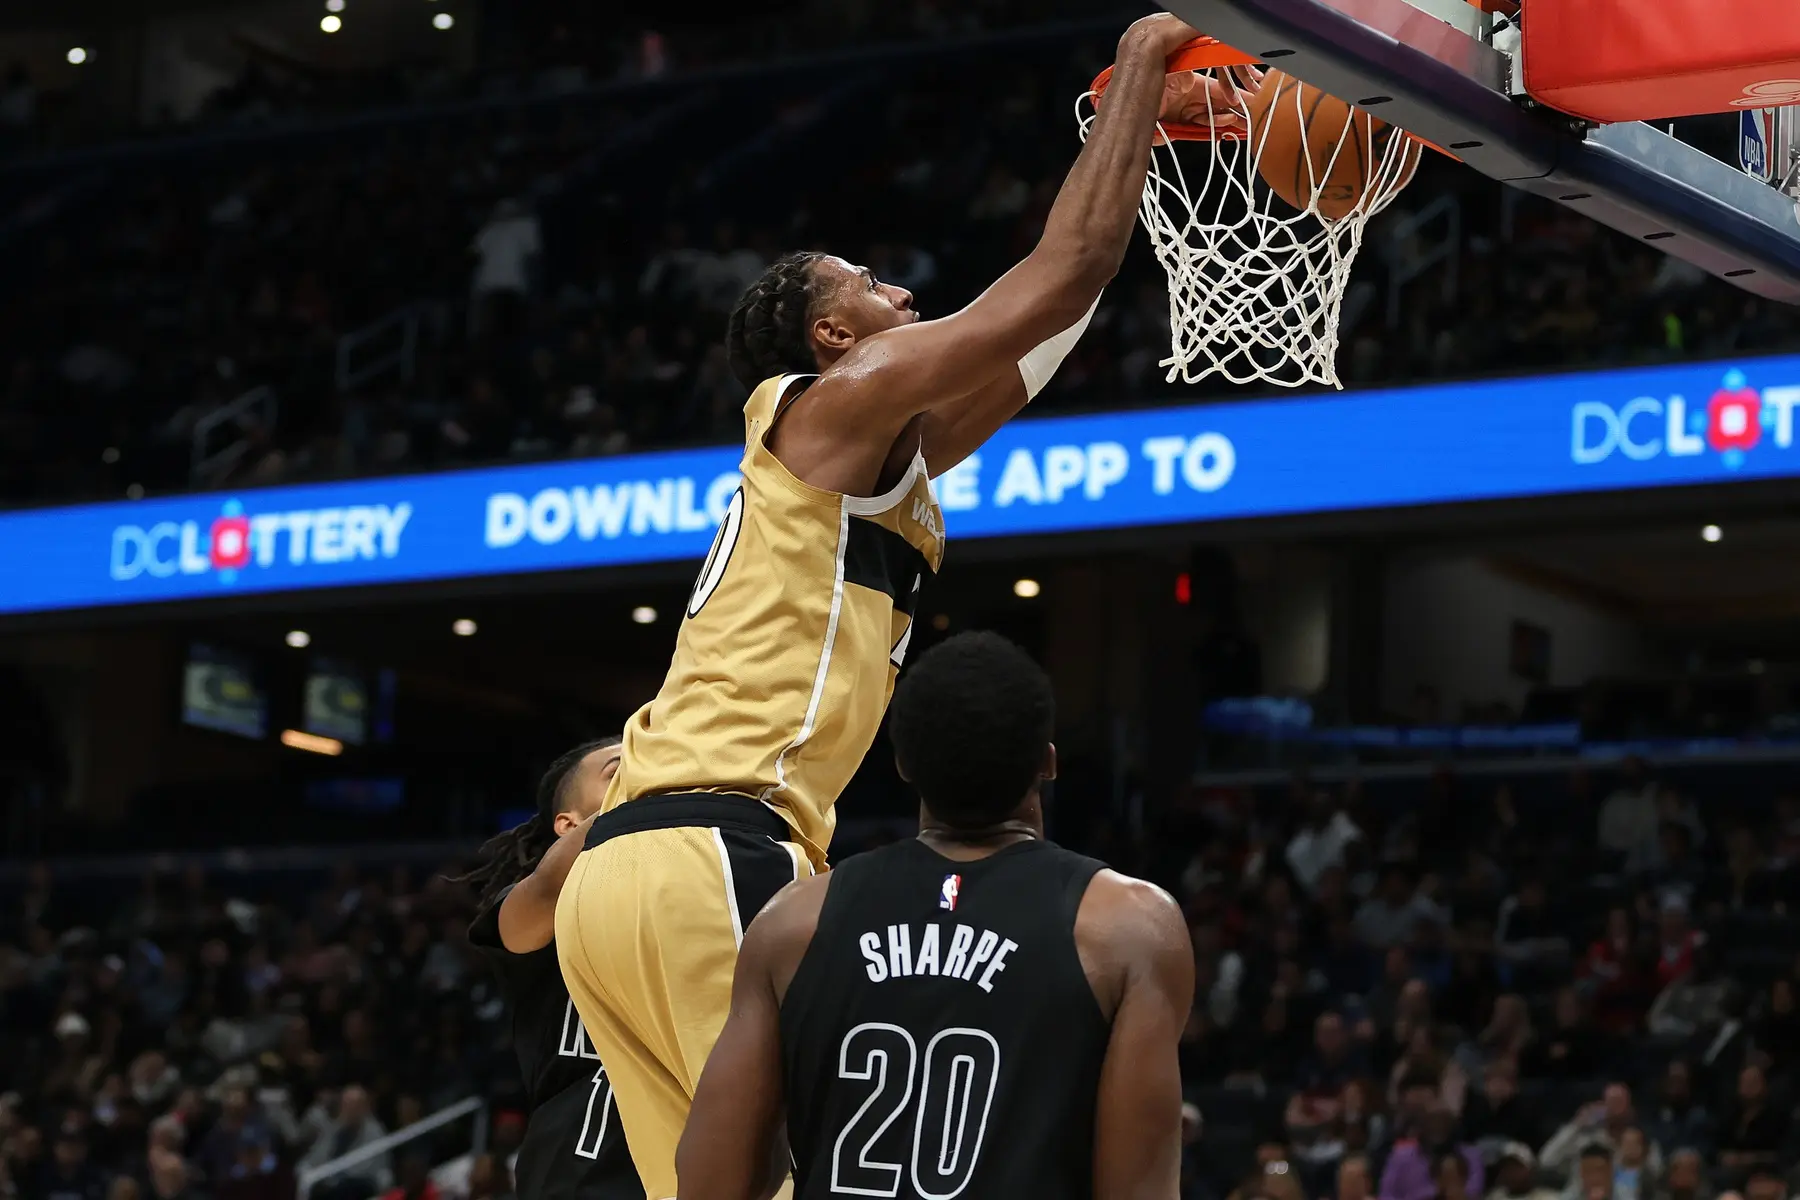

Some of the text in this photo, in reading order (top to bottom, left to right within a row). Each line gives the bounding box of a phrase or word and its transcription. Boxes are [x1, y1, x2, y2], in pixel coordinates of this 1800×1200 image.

[1744, 135, 1761, 168] NBA
[930, 452, 982, 511] E
[993, 440, 1130, 507] APP
[1141, 431, 1236, 496] TO
[859, 923, 1019, 993] SHARPE
[830, 1022, 1000, 1200] 20
